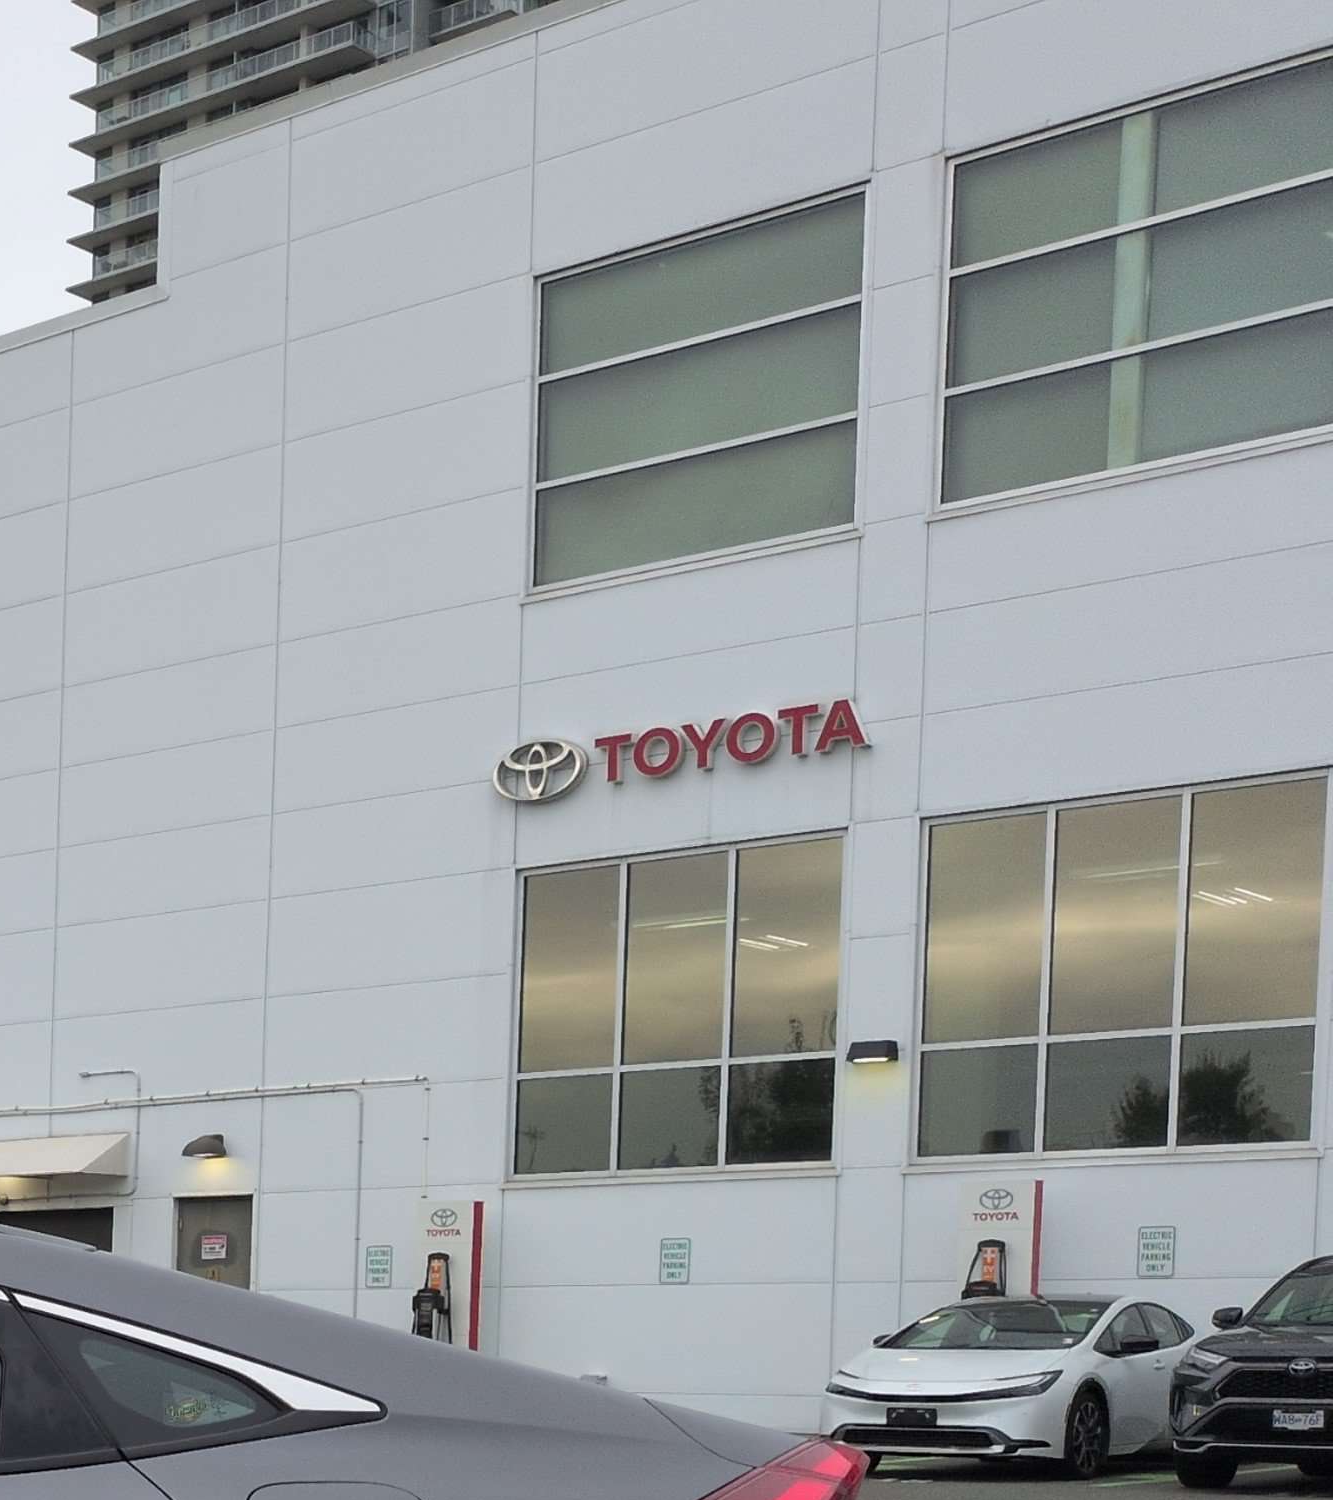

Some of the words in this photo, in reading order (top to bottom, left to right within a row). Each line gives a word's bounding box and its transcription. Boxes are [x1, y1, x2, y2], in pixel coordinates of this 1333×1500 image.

[594, 698, 870, 785] TOYOTA
[973, 1211, 1019, 1221] TOYOTA
[426, 1229, 461, 1237] TOYOTA
[1141, 1253, 1171, 1261] PARKING
